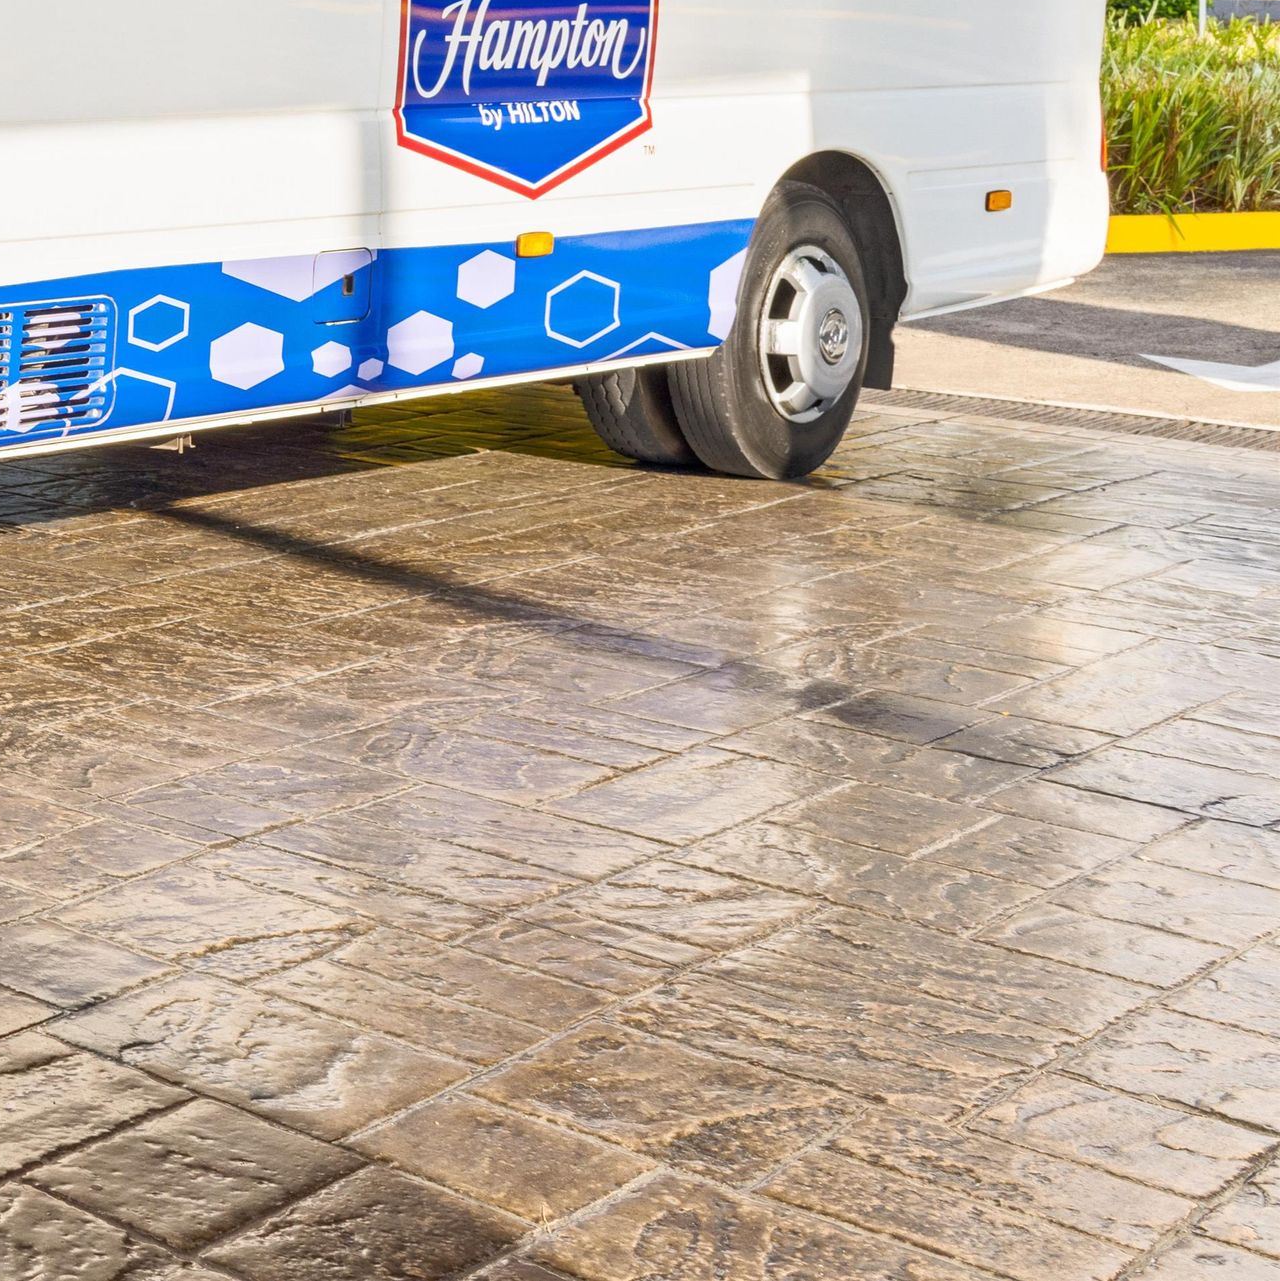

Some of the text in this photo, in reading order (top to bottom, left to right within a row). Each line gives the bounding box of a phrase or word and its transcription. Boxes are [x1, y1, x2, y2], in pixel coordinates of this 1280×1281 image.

[479, 100, 581, 131] by HILTON
[643, 145, 656, 156] TM
